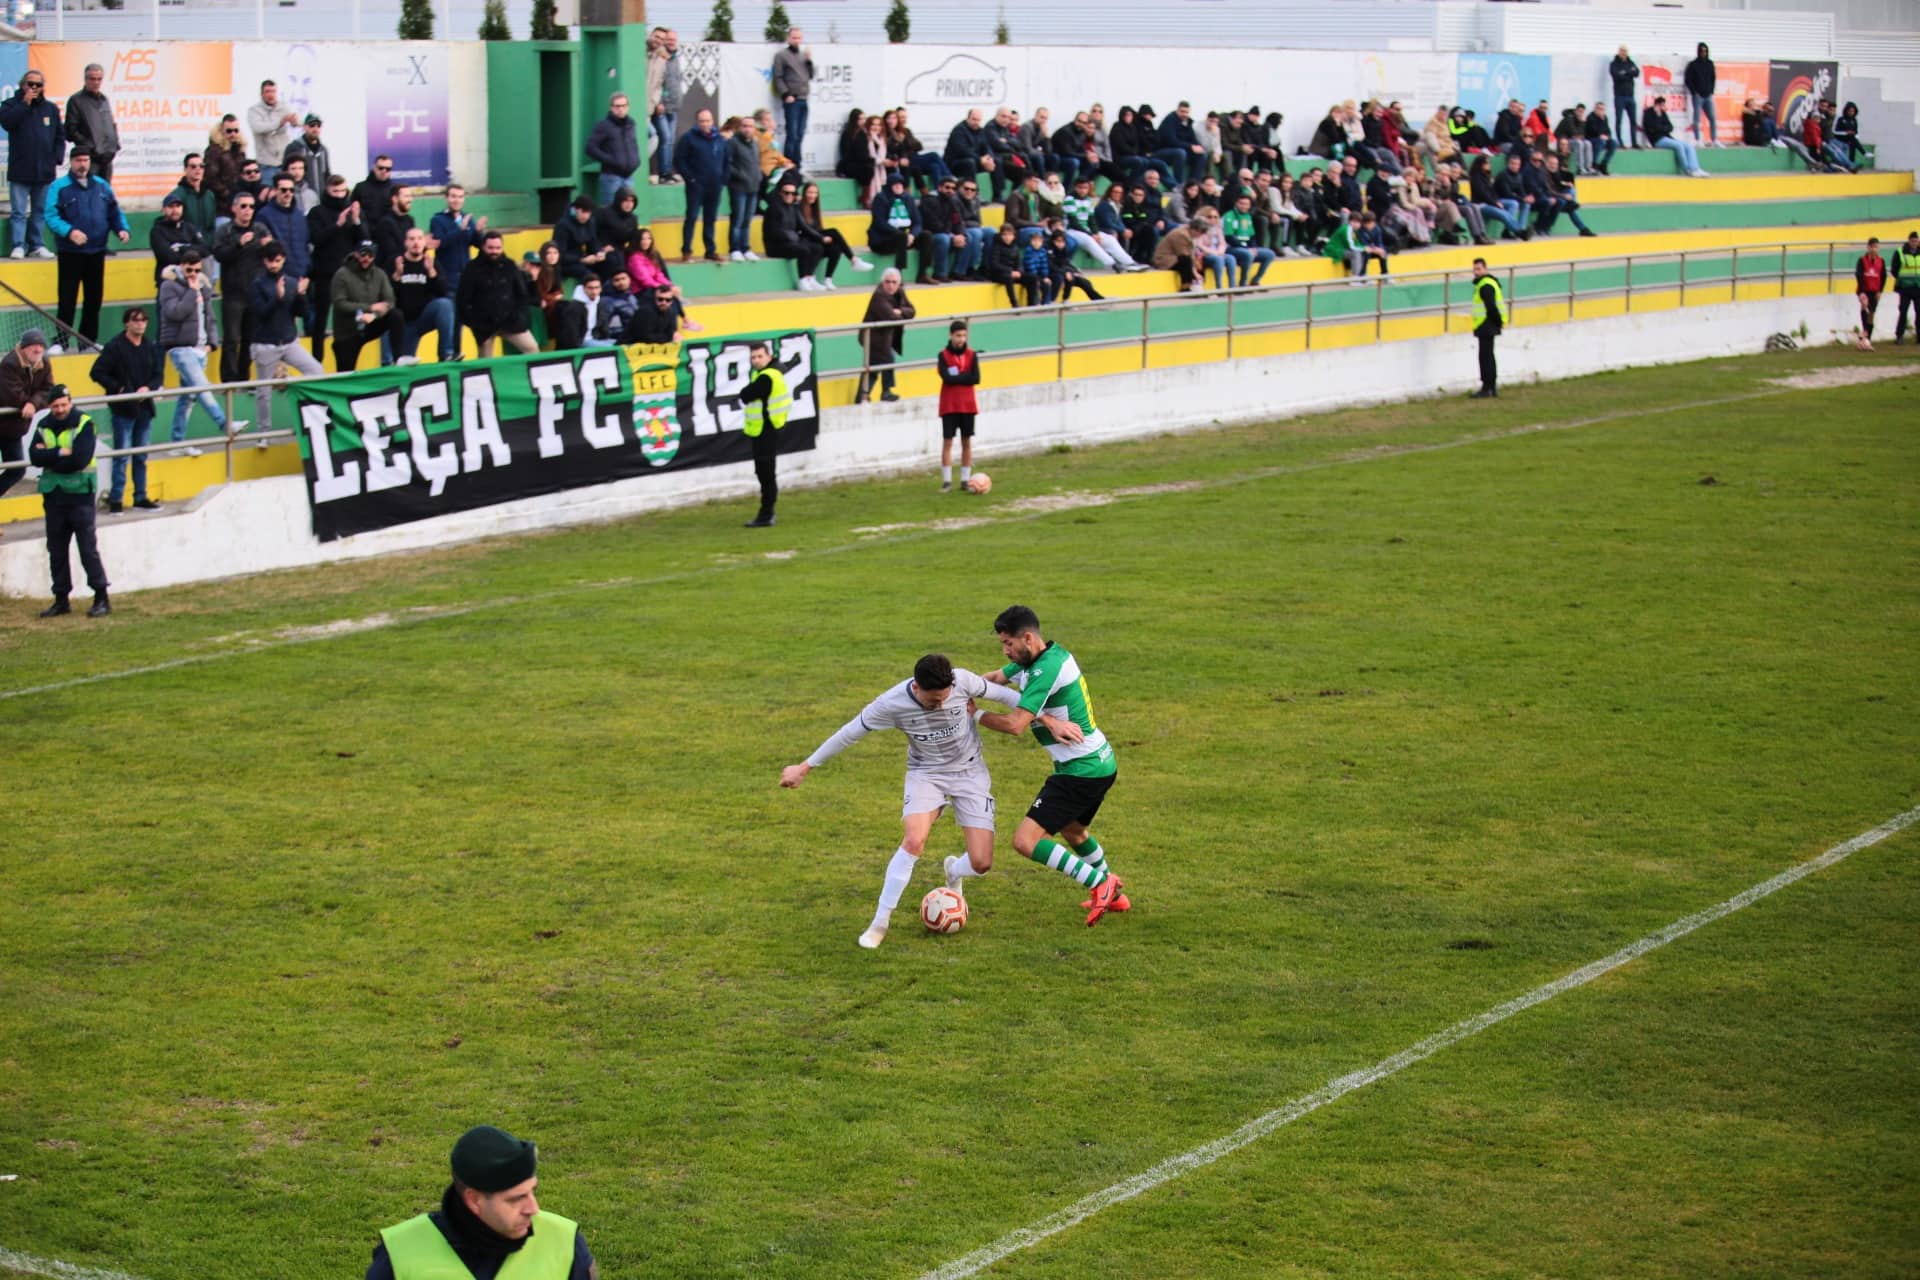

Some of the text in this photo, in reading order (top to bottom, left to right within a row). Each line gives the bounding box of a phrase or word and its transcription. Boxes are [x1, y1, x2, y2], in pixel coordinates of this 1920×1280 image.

[813, 65, 852, 82] LIPE
[936, 79, 994, 97] PRINCIPE
[114, 97, 222, 118] HARIA CIVIL
[300, 334, 817, 503] LEÇA FC 192
